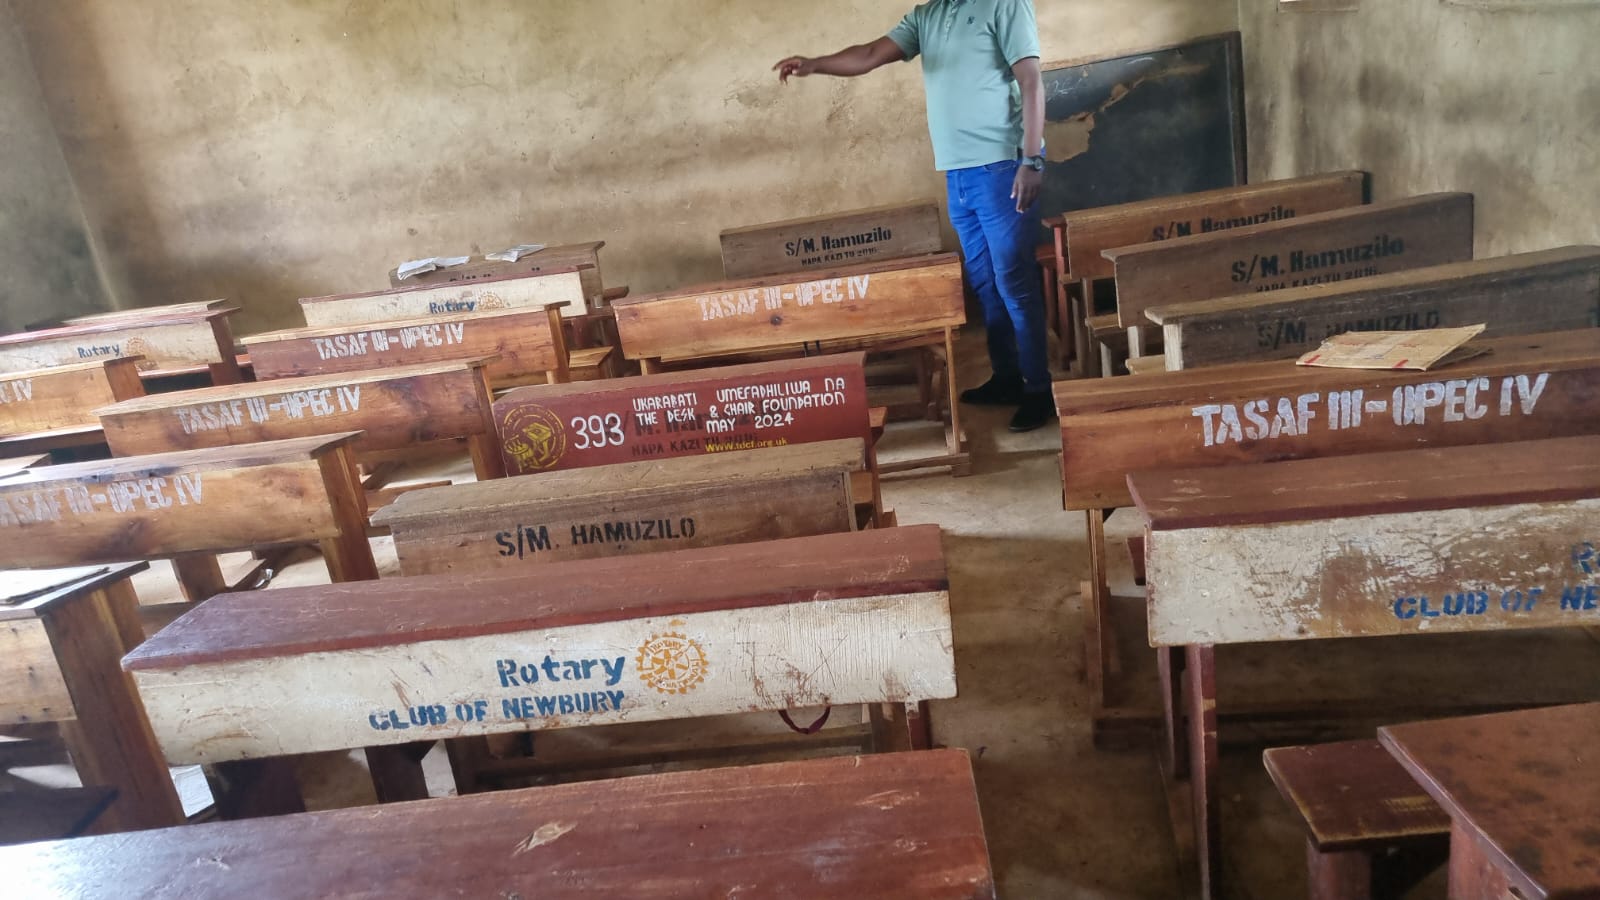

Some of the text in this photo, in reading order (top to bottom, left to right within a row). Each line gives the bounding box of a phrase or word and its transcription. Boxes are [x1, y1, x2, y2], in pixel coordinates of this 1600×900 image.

[821, 227, 892, 250] Hamuzilo
[1231, 235, 1406, 283] S/M. Hamuzilo
[429, 300, 476, 315] Rotary
[696, 289, 759, 321] TASAF
[847, 274, 870, 300] IV
[77, 343, 120, 359] Rotary
[310, 332, 368, 360] TASAF
[444, 322, 465, 345] IV
[174, 399, 245, 434] TASAF
[336, 386, 360, 412] IV
[632, 393, 698, 412] UKARABATI
[716, 380, 811, 403] UMEFADHILIWA
[636, 411, 658, 426] THE
[667, 407, 696, 423] DESK
[709, 405, 719, 418] &
[723, 401, 755, 416] CHAIR
[762, 391, 845, 413] FOUNDATION
[1192, 393, 1319, 447] TASAF
[1500, 373, 1549, 416] IV
[571, 412, 625, 450] 393
[706, 418, 736, 434] MAY
[754, 412, 794, 428] 2024
[174, 473, 203, 506] IV
[495, 517, 695, 560] S/M. HAMUZILO
[1393, 590, 1490, 620] CLUB
[496, 655, 626, 688] Rotary
[369, 690, 625, 731] CLUB OF NEWBURY
